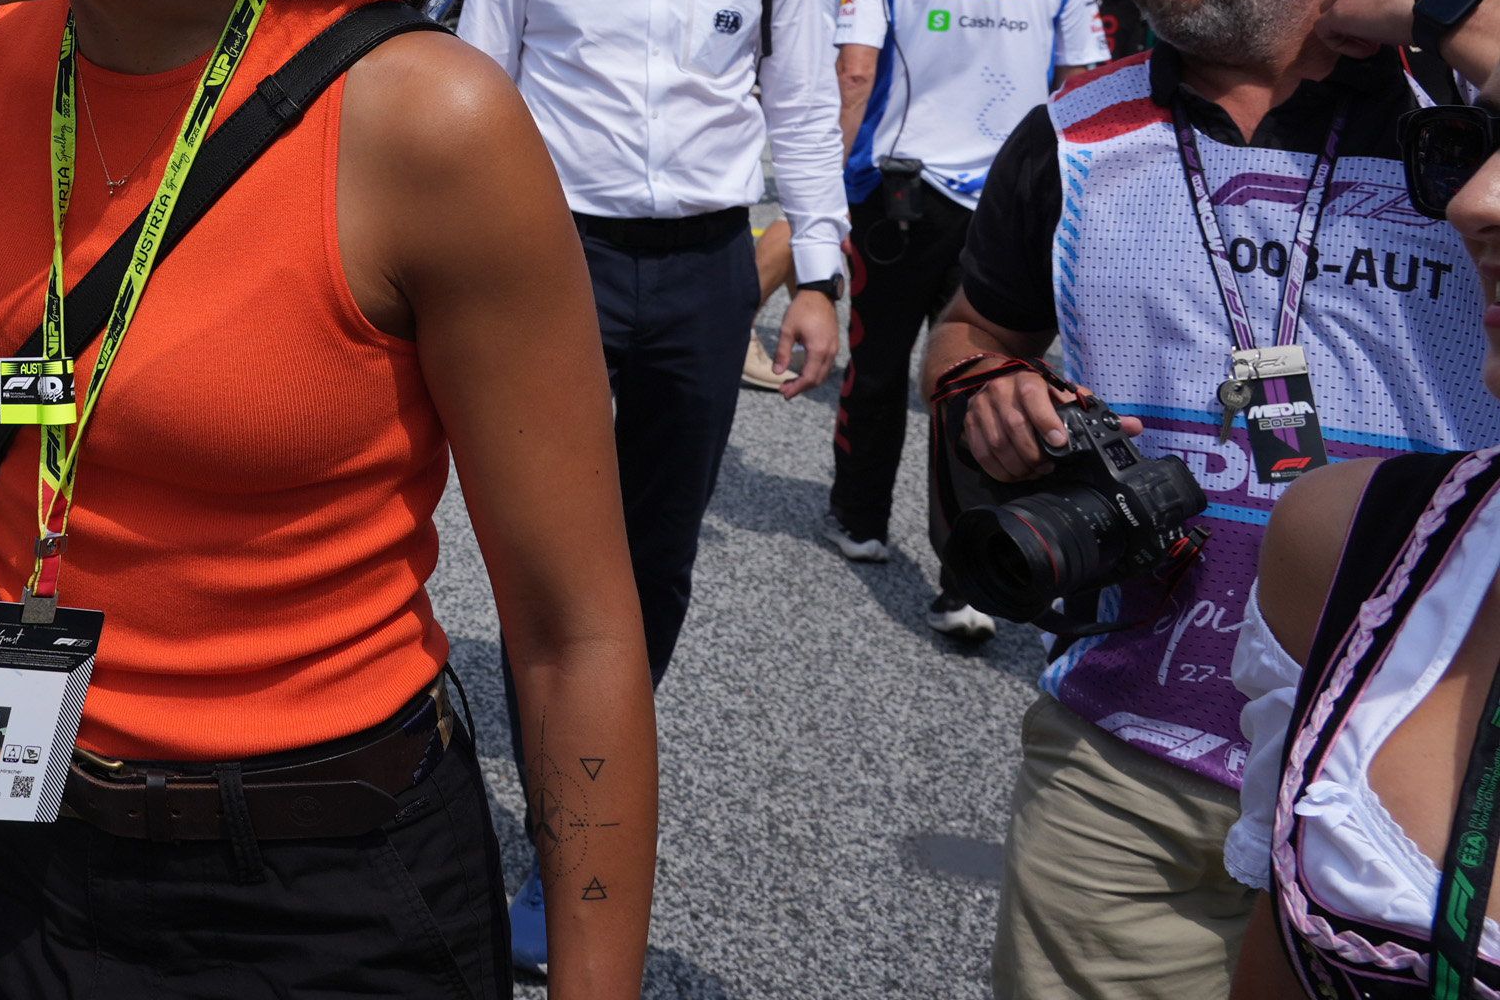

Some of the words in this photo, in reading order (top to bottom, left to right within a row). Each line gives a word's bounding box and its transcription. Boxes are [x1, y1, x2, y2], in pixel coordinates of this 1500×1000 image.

[958, 15, 995, 29] Cash
[999, 17, 1029, 31] App
[134, 193, 171, 276] AUSTRIA
[206, 53, 233, 87] VIP
[1196, 193, 1225, 252] MEDIA
[1296, 186, 1325, 246] MEDIA
[48, 321, 59, 358] VIP
[97, 337, 113, 370] VIP
[1247, 401, 1315, 420] MEDIA
[1258, 415, 1307, 431] 2025
[1115, 493, 1140, 528] Canon
[1179, 663, 1216, 683] 27
